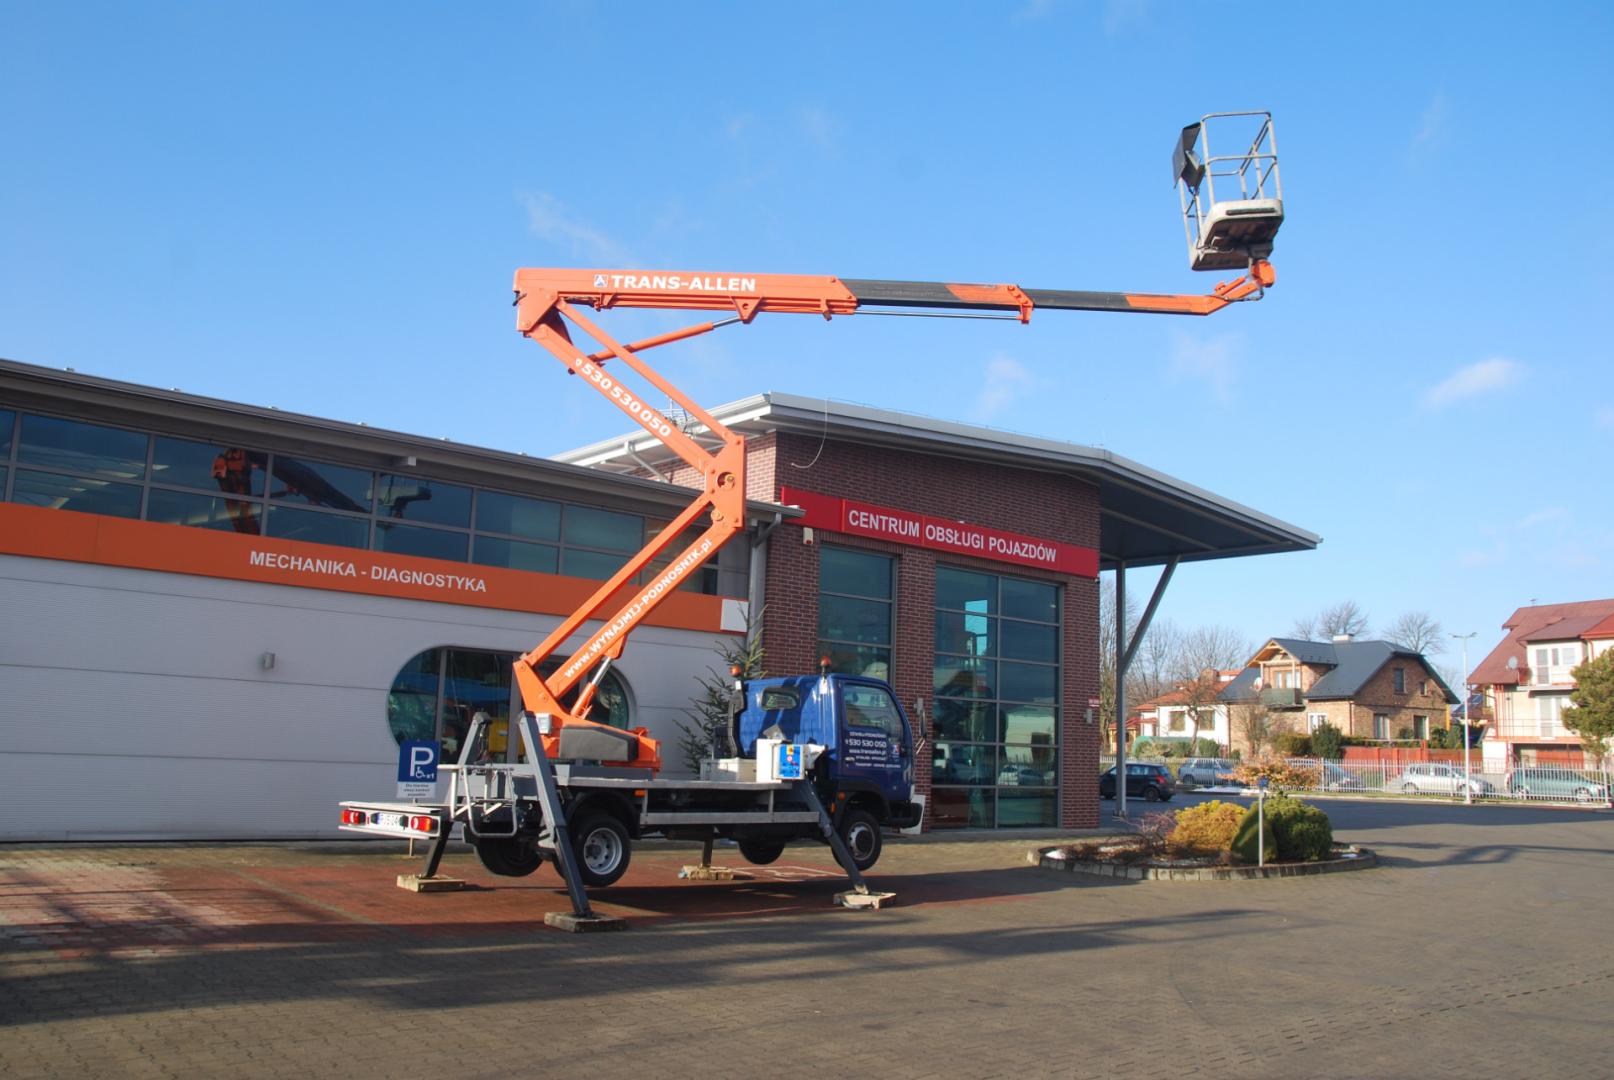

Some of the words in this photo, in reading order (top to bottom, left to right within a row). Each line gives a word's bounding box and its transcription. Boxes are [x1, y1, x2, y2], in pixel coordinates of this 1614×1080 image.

[611, 274, 756, 292] TRANS-ALLEN
[581, 362, 612, 390] 530
[610, 386, 642, 414] 530
[640, 409, 672, 437] 050
[849, 509, 920, 538] CENTRUM
[925, 524, 984, 549] OBSŁUGI
[989, 537, 1057, 562] POJAZDÓW
[250, 551, 357, 577] MECHANIKA
[371, 566, 487, 593] DIAGNOSTYKA
[410, 747, 434, 777] P
